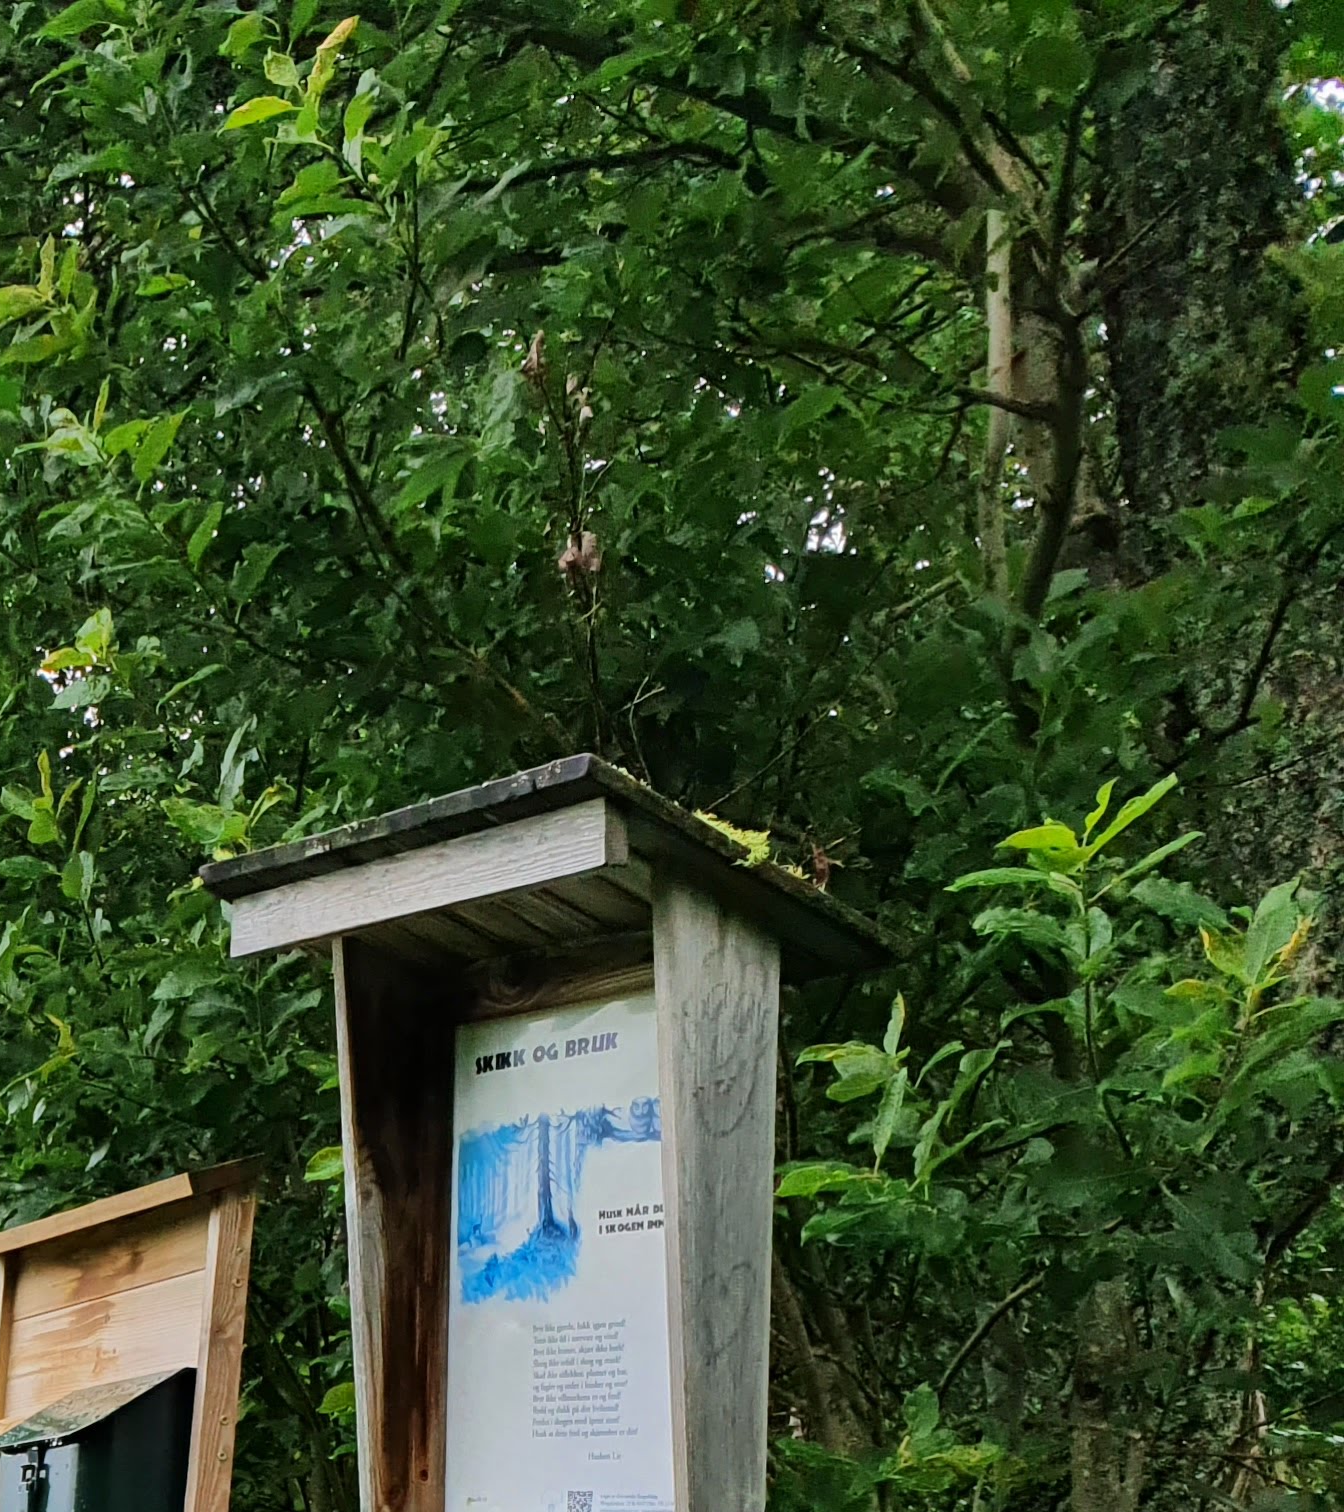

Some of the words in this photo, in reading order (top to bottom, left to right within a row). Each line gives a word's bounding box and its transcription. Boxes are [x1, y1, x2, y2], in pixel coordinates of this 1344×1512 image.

[476, 1048, 526, 1075] SKIKK
[532, 1042, 559, 1063] OG
[565, 1032, 618, 1059] BRUK
[626, 1203, 649, 1217] NÅR
[606, 1221, 644, 1234] SKOGEN
